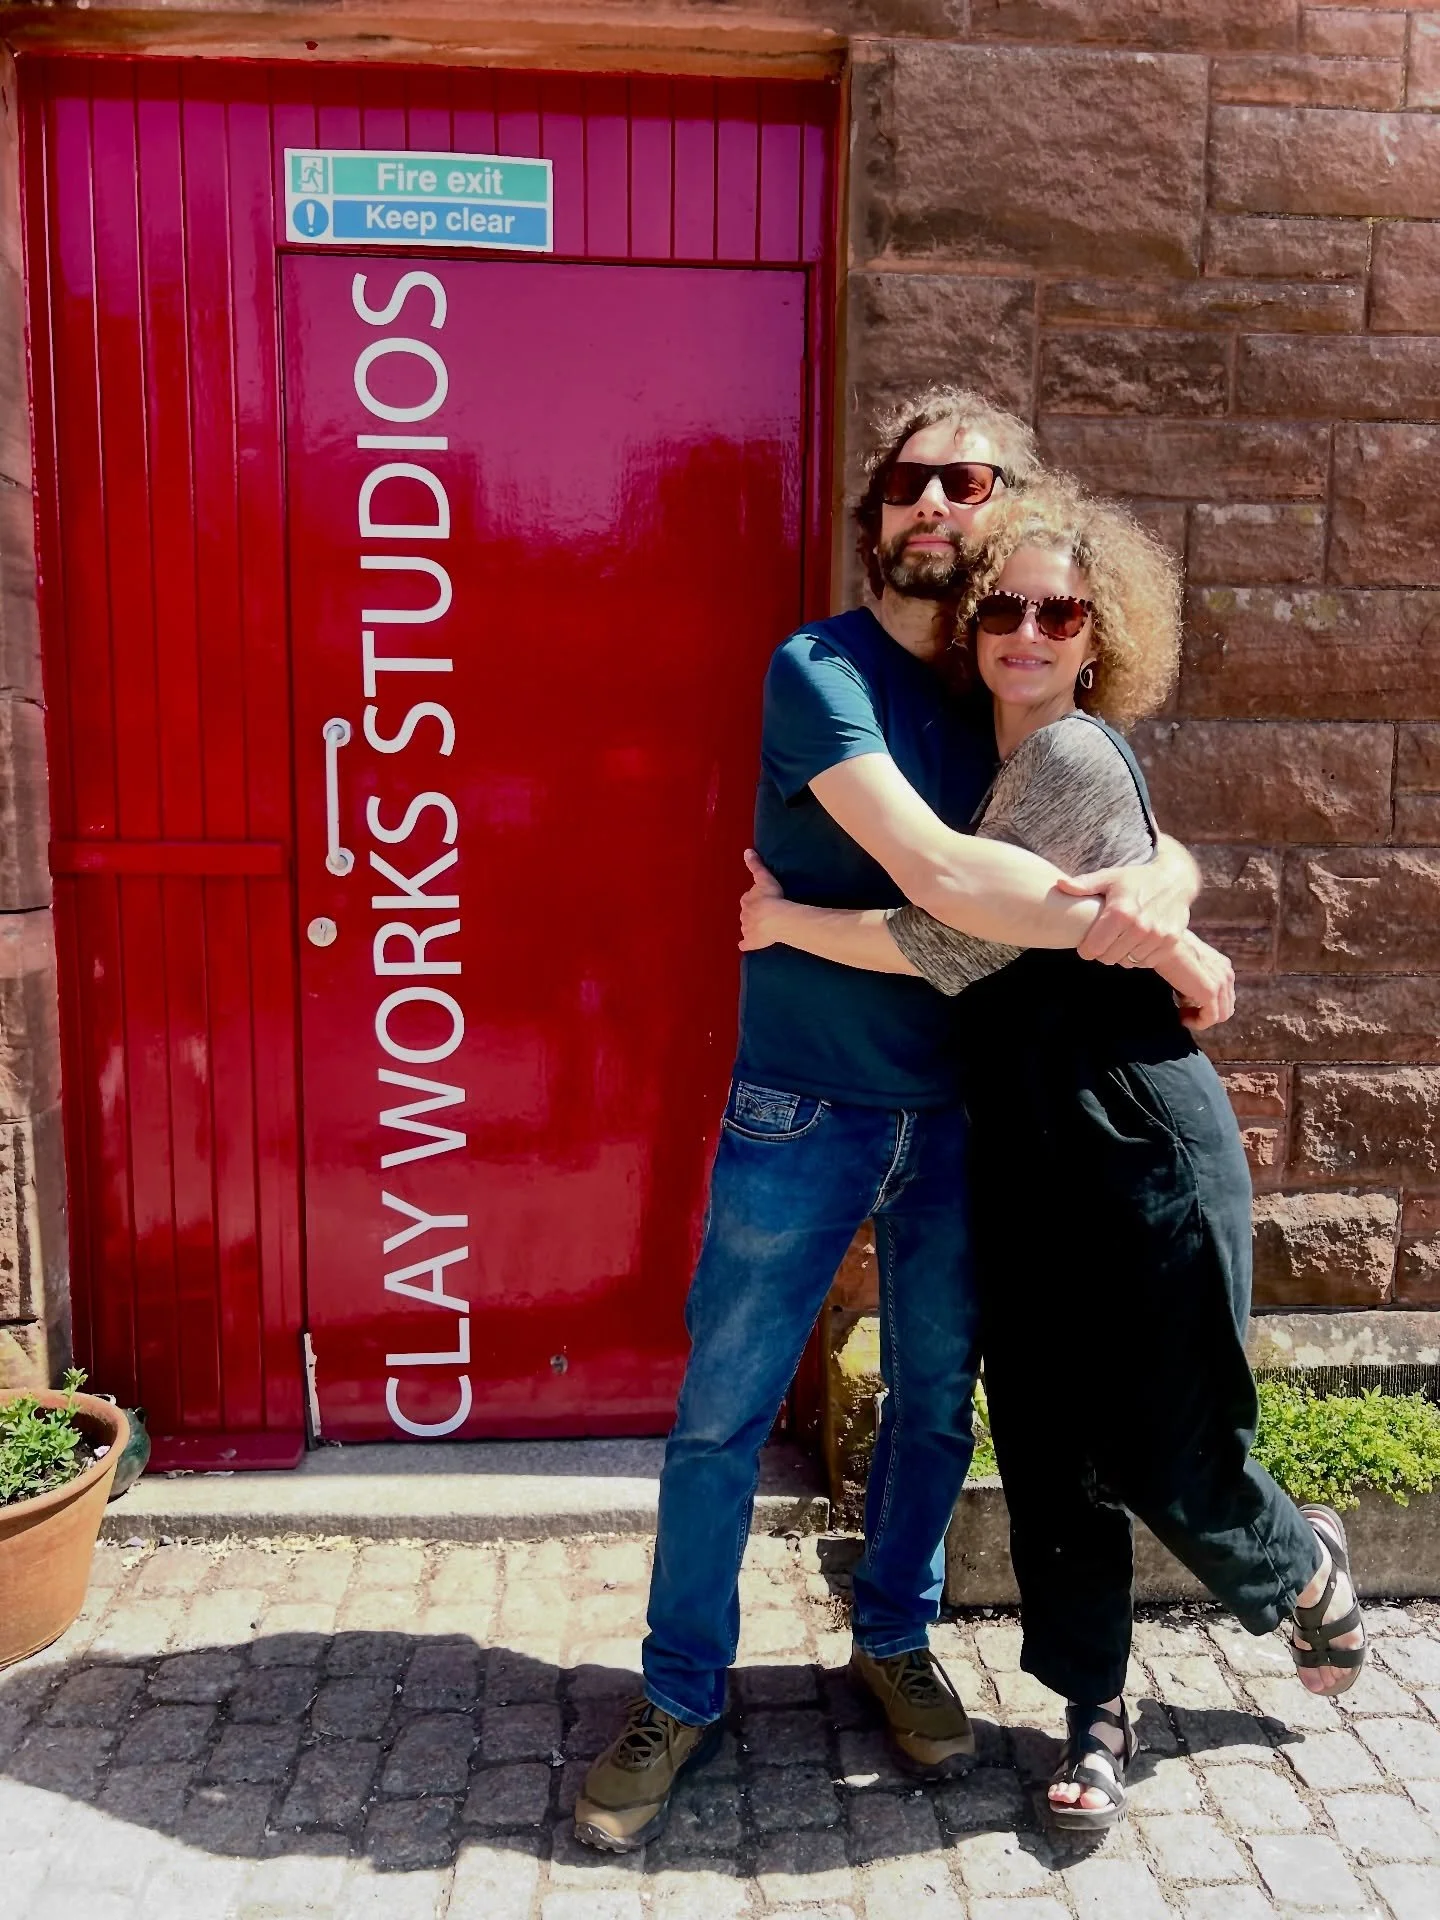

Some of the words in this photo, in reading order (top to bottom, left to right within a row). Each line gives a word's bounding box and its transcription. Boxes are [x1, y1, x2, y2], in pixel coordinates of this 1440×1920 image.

[365, 204, 437, 235] Keep
[446, 206, 516, 234] clear
[376, 162, 437, 193] Fire
[447, 166, 504, 195] exit
[351, 270, 456, 757] STUDIOS
[366, 791, 467, 1169] WORKS
[381, 1190, 473, 1437] CLAY
